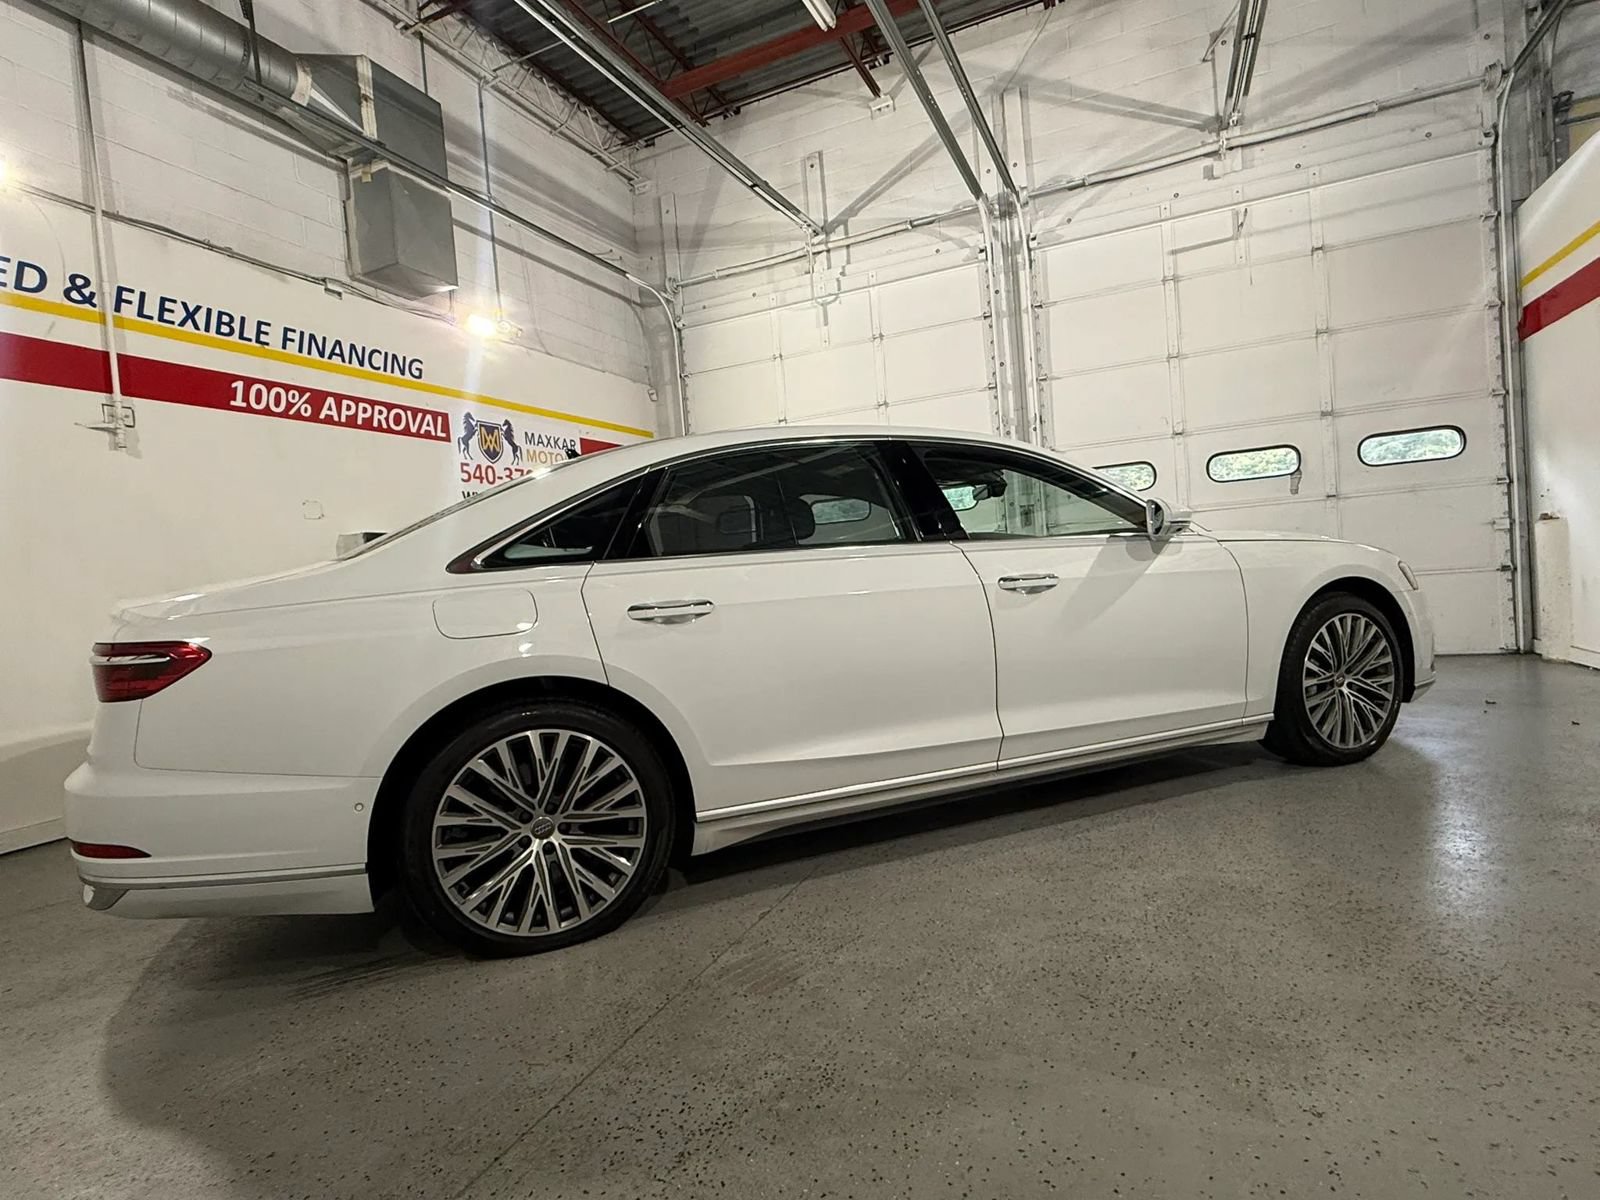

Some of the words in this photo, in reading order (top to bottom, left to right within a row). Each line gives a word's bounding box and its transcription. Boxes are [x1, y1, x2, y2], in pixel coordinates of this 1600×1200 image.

[63, 273, 97, 308] &
[113, 285, 272, 346] FLEXIBLE
[281, 326, 424, 380] FINANCING
[229, 380, 312, 418] 100%
[318, 396, 447, 438] APPROVAL
[524, 431, 577, 451] MAXKAR
[526, 448, 568, 465] MOTO
